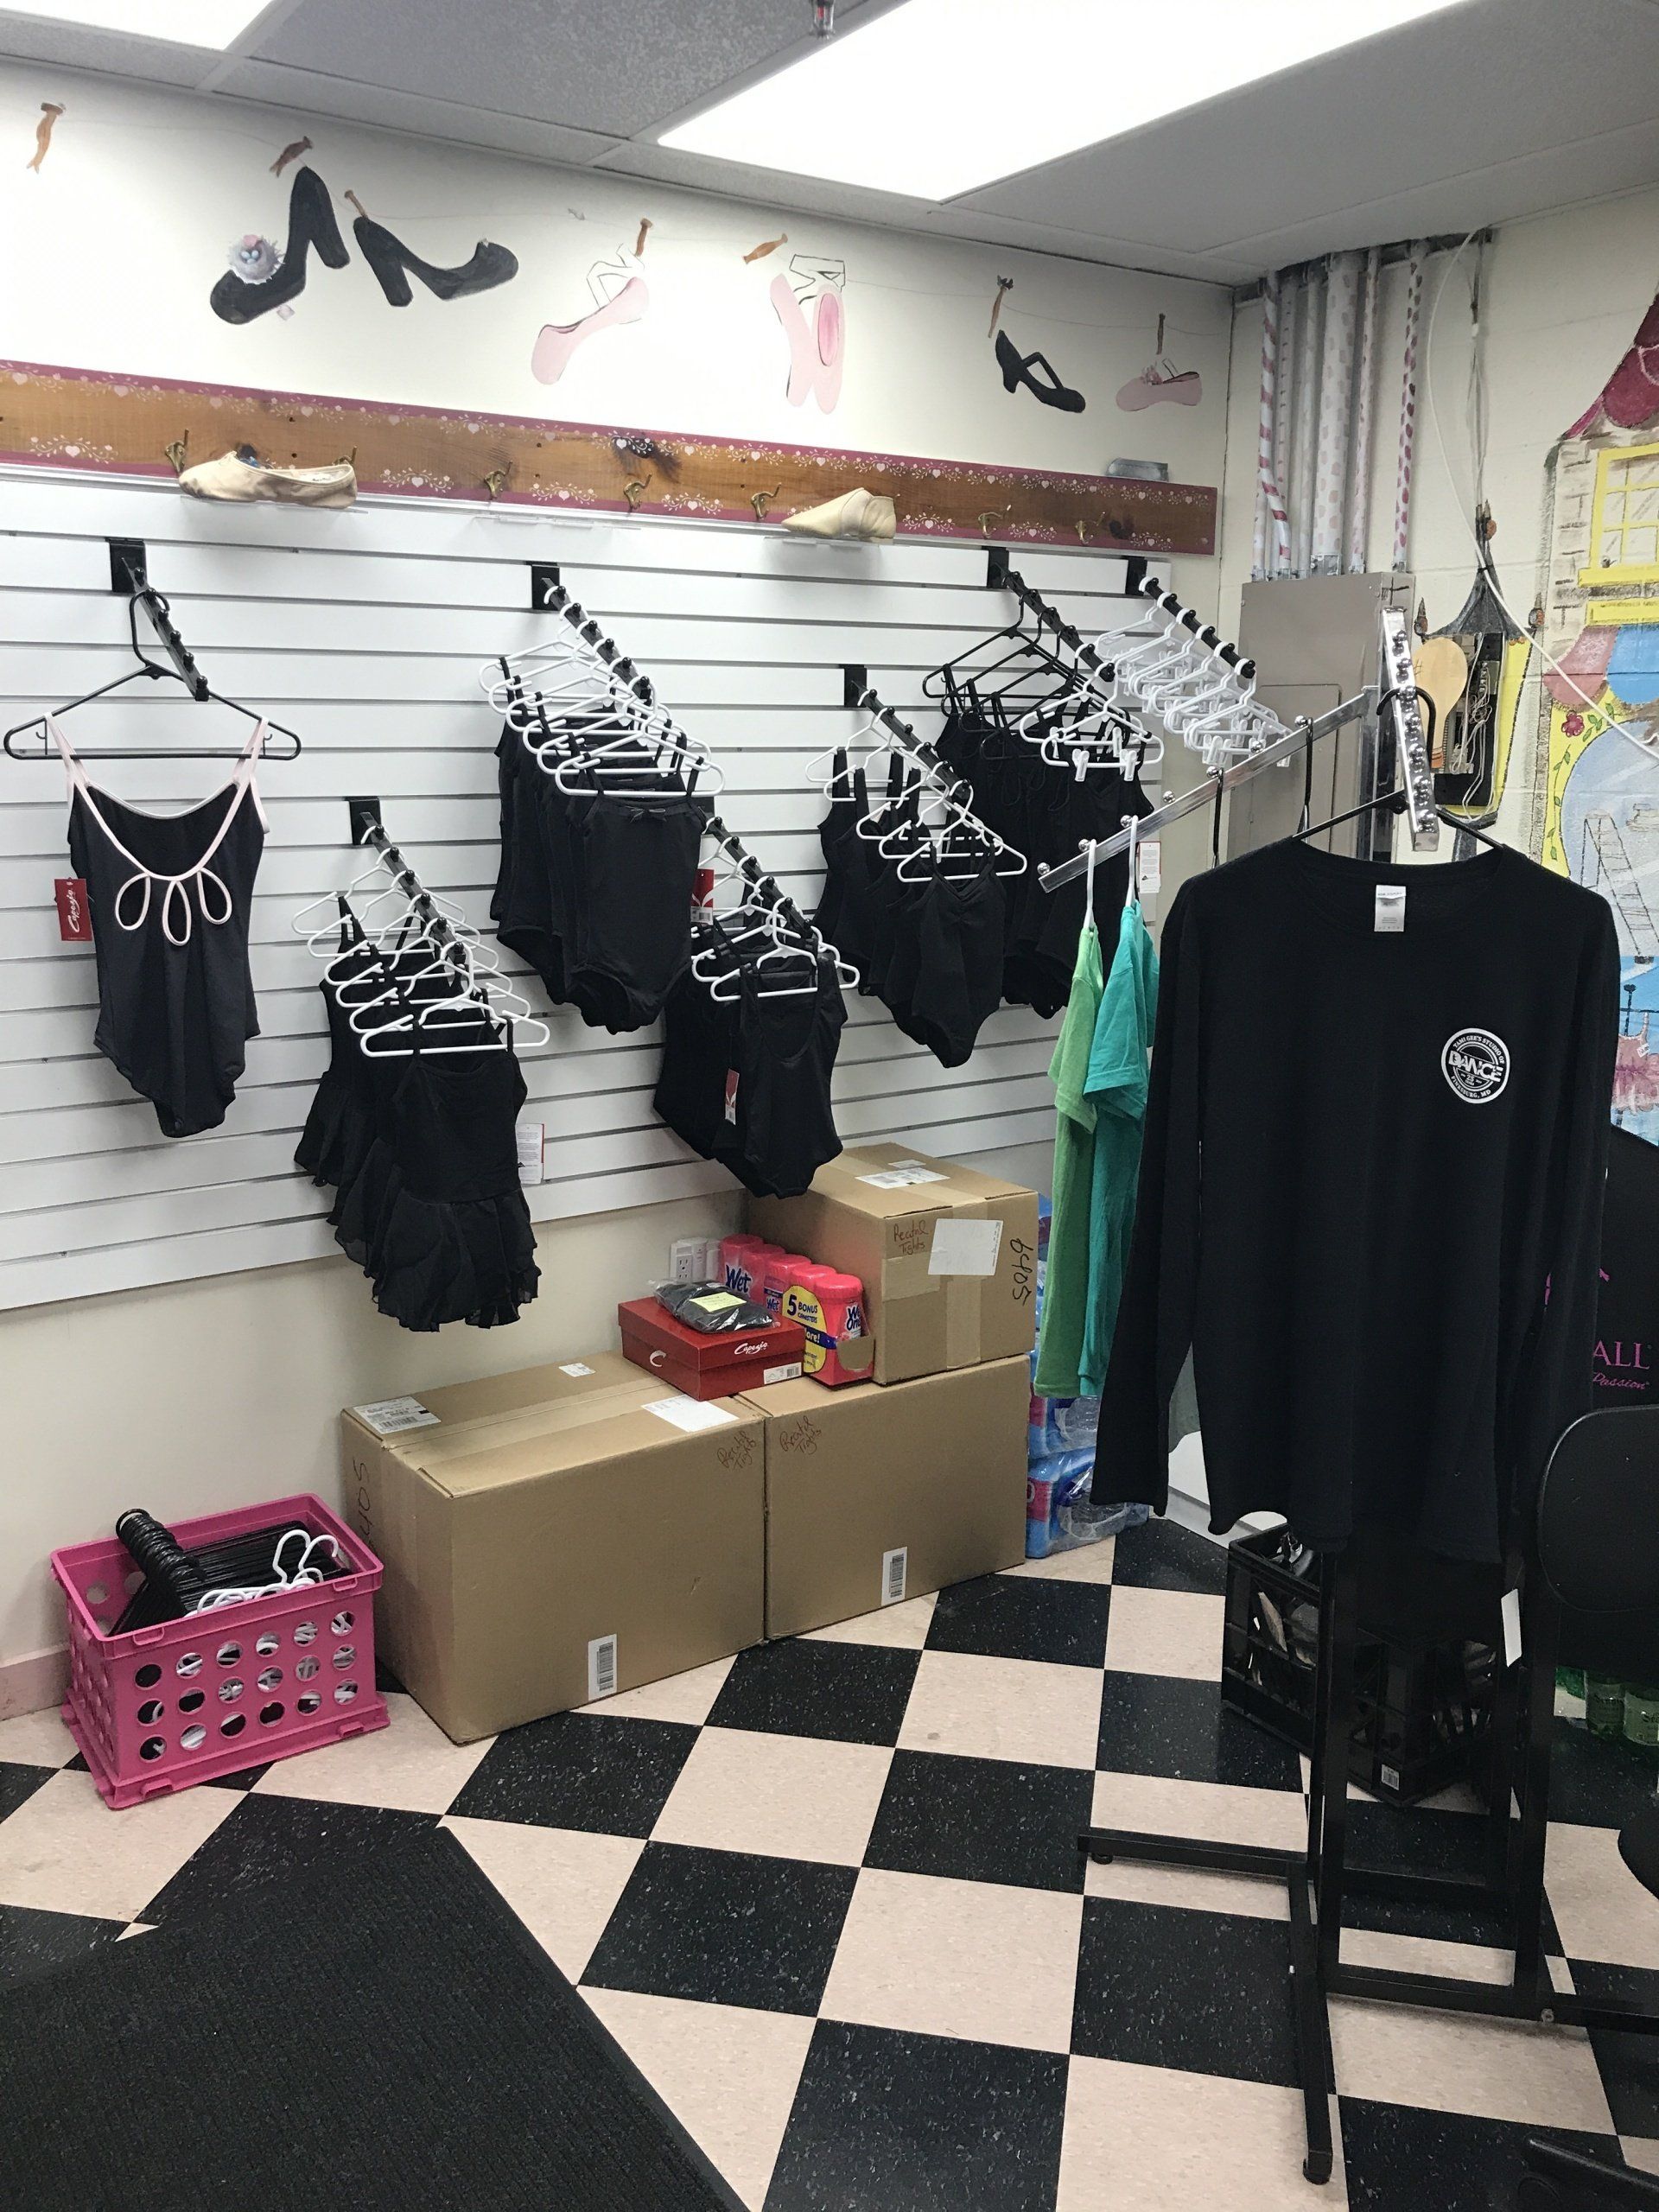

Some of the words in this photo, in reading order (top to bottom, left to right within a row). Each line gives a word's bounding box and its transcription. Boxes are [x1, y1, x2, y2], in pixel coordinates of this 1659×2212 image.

[1482, 1038, 1503, 1056] STUDIO
[1448, 1050, 1504, 1083] DANCE
[1480, 1089, 1491, 1097] MD
[725, 1264, 752, 1294] Wet
[786, 1294, 798, 1316] 5
[798, 1301, 818, 1314] BONUS
[804, 1328, 821, 1344] ore!
[734, 1340, 768, 1355] Capezio
[352, 1455, 374, 1547] 405
